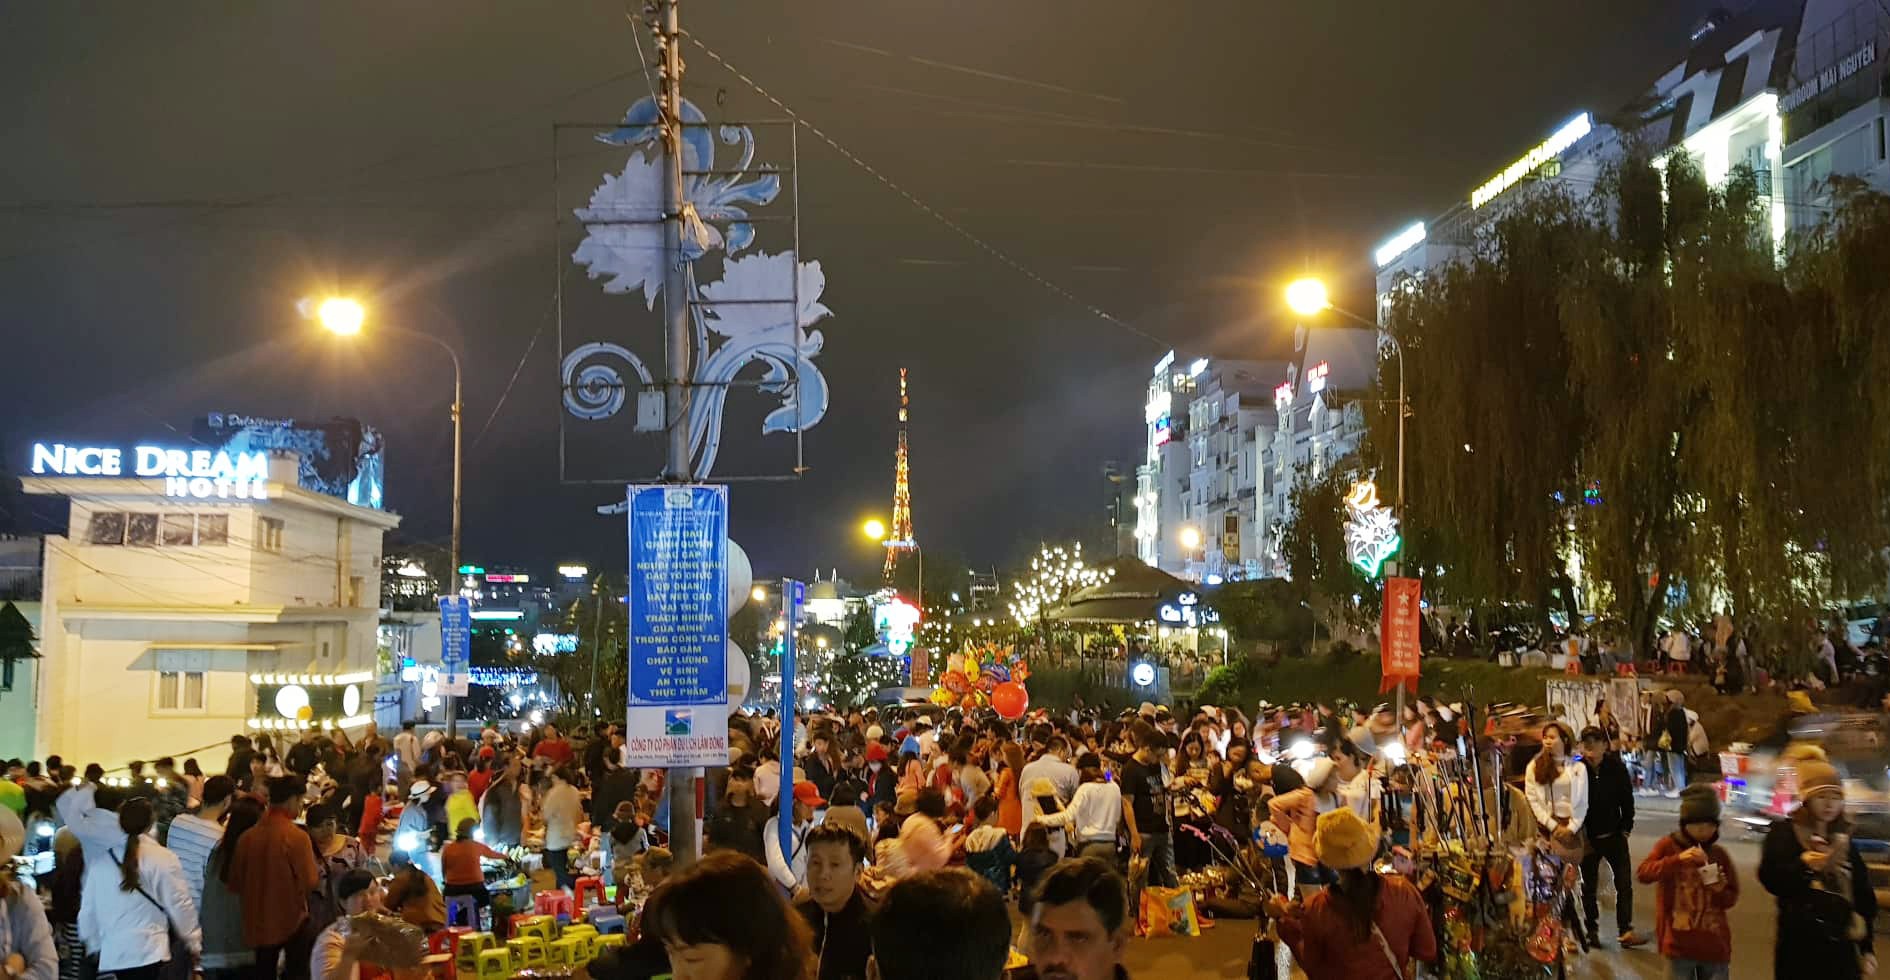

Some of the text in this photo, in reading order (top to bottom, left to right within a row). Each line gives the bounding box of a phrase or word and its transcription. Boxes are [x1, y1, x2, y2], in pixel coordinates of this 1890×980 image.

[1820, 66, 1838, 92] MAI
[31, 443, 269, 479] NICE DREAM
[166, 477, 268, 500] HOTEL
